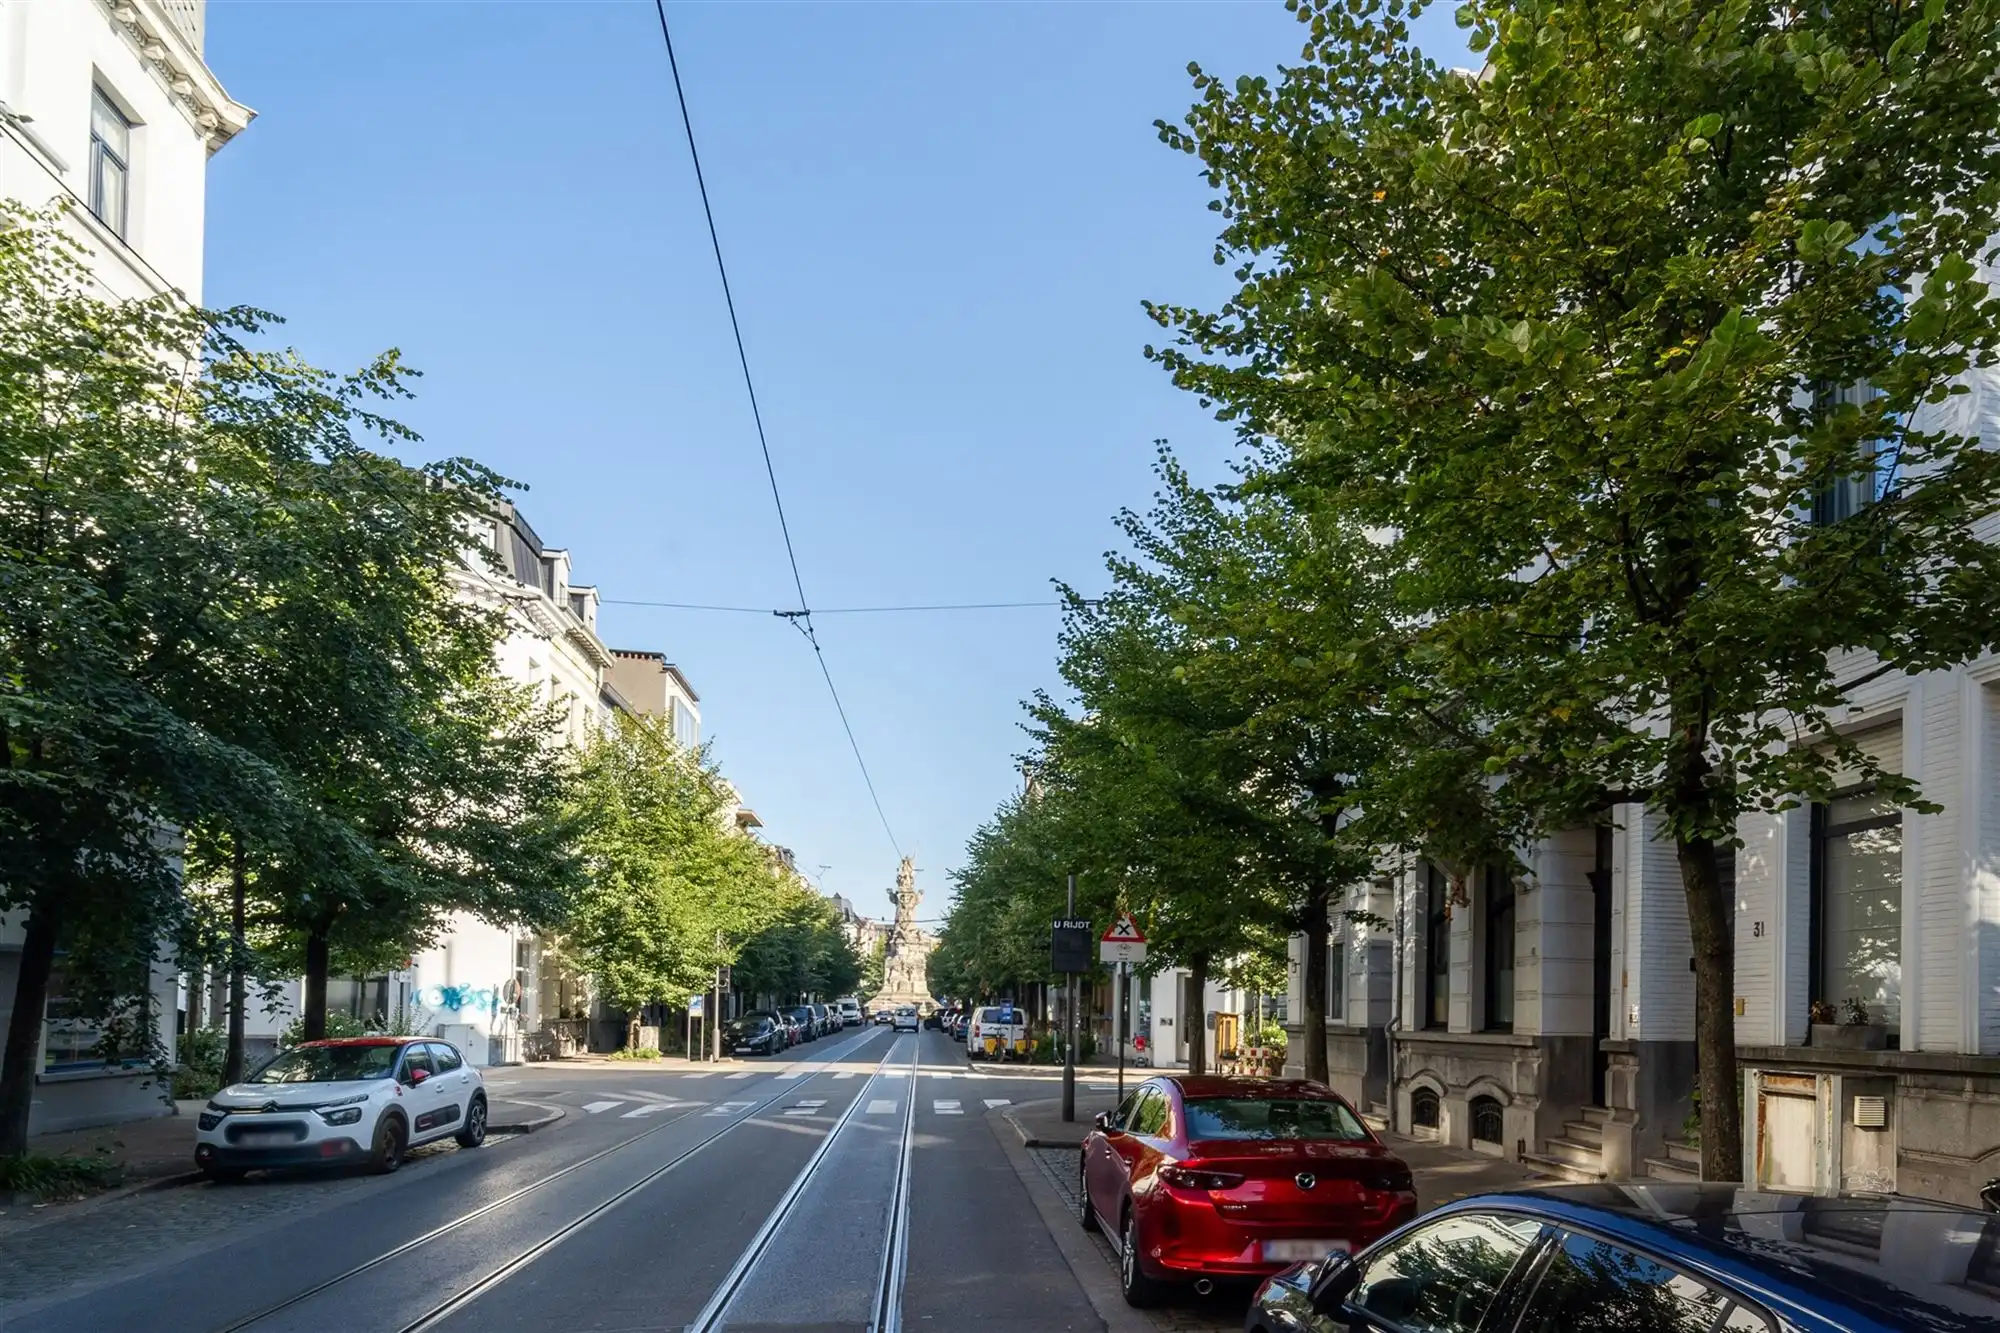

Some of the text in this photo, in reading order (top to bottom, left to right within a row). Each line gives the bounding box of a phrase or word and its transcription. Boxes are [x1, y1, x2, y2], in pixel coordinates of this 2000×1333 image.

[1053, 920, 1090, 929] U RIJDT
[1753, 920, 1765, 938] 31
